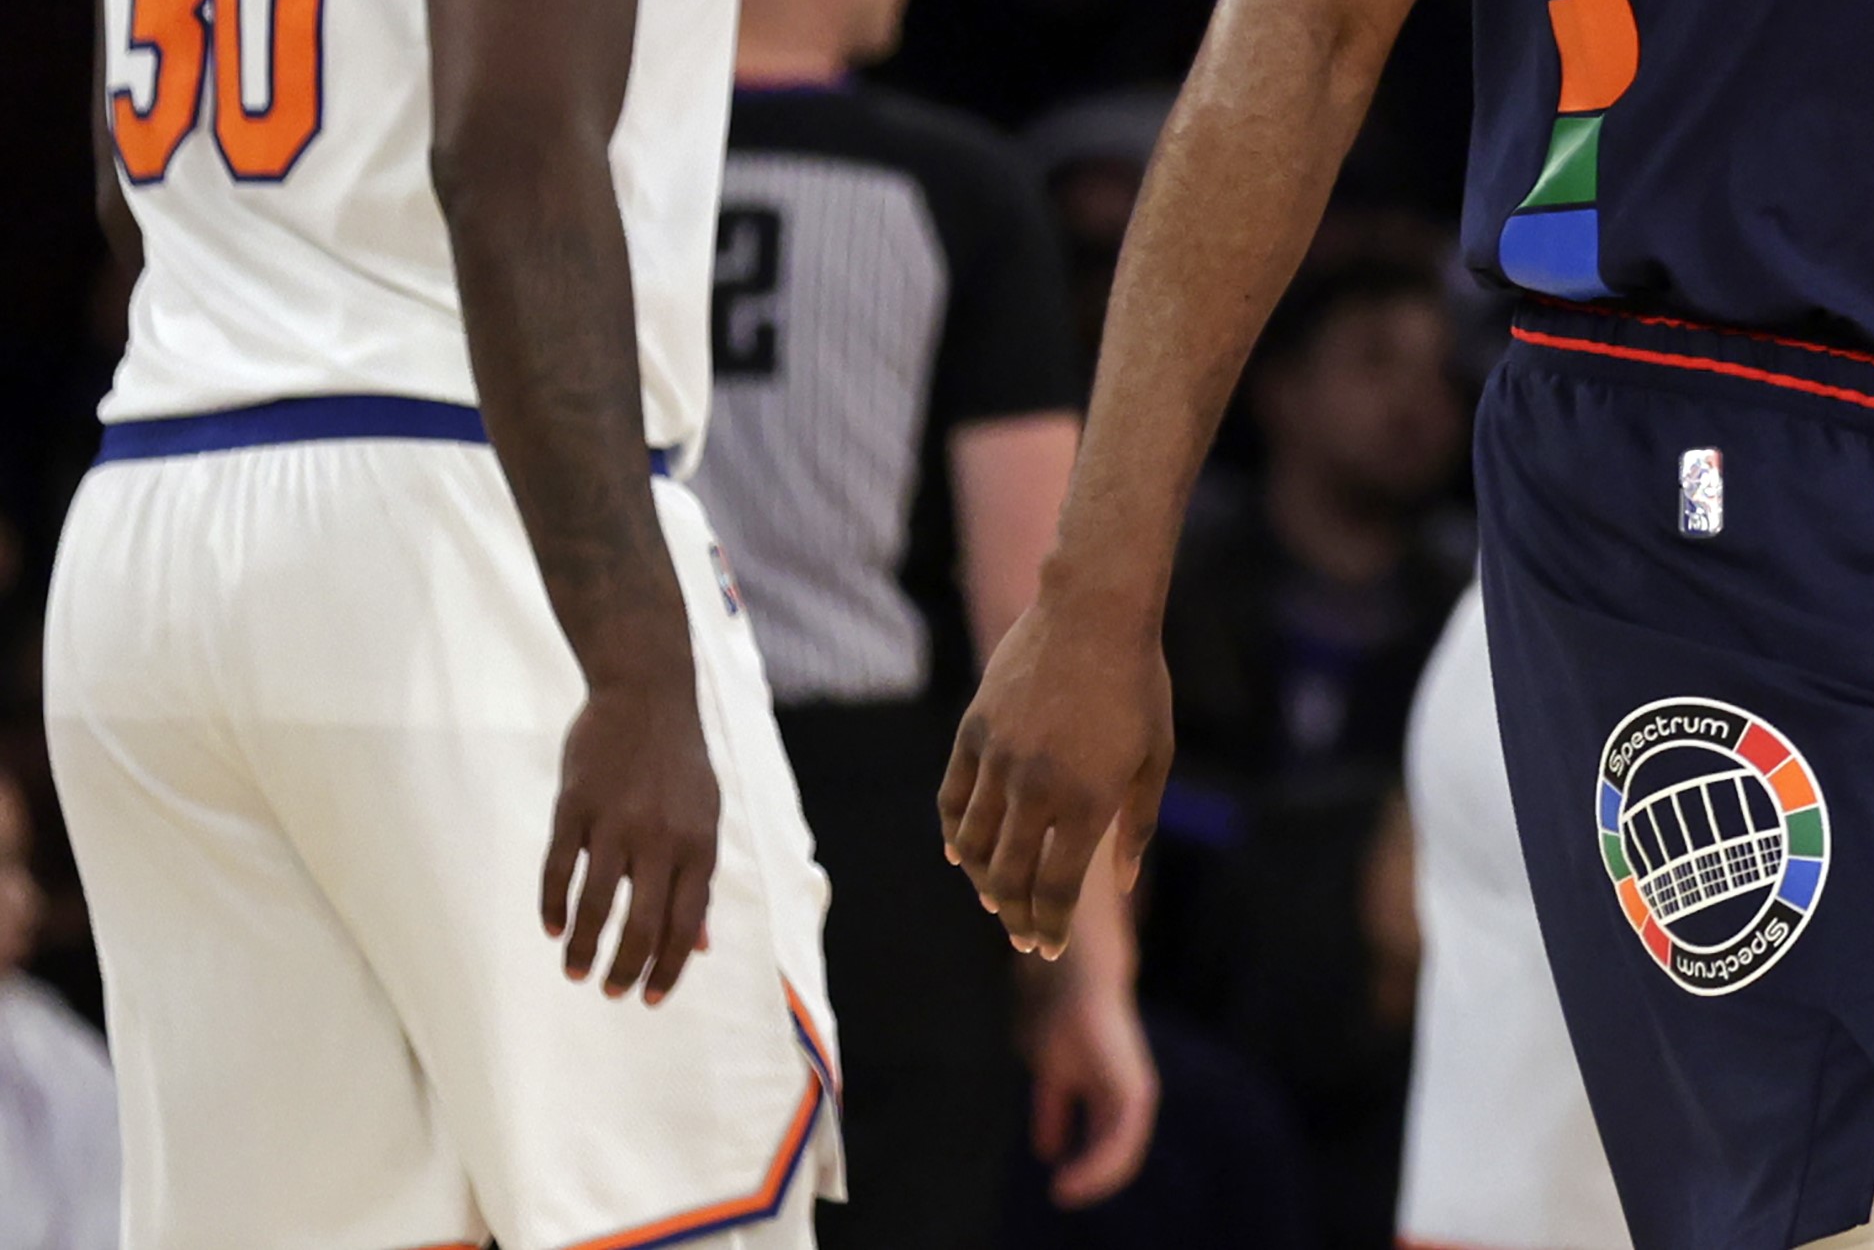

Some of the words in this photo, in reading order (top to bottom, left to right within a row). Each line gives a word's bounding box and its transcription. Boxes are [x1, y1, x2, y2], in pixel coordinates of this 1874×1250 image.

[713, 208, 778, 376] 2
[1607, 713, 1731, 778] Spectrum
[1675, 915, 1792, 981] Spectrum
